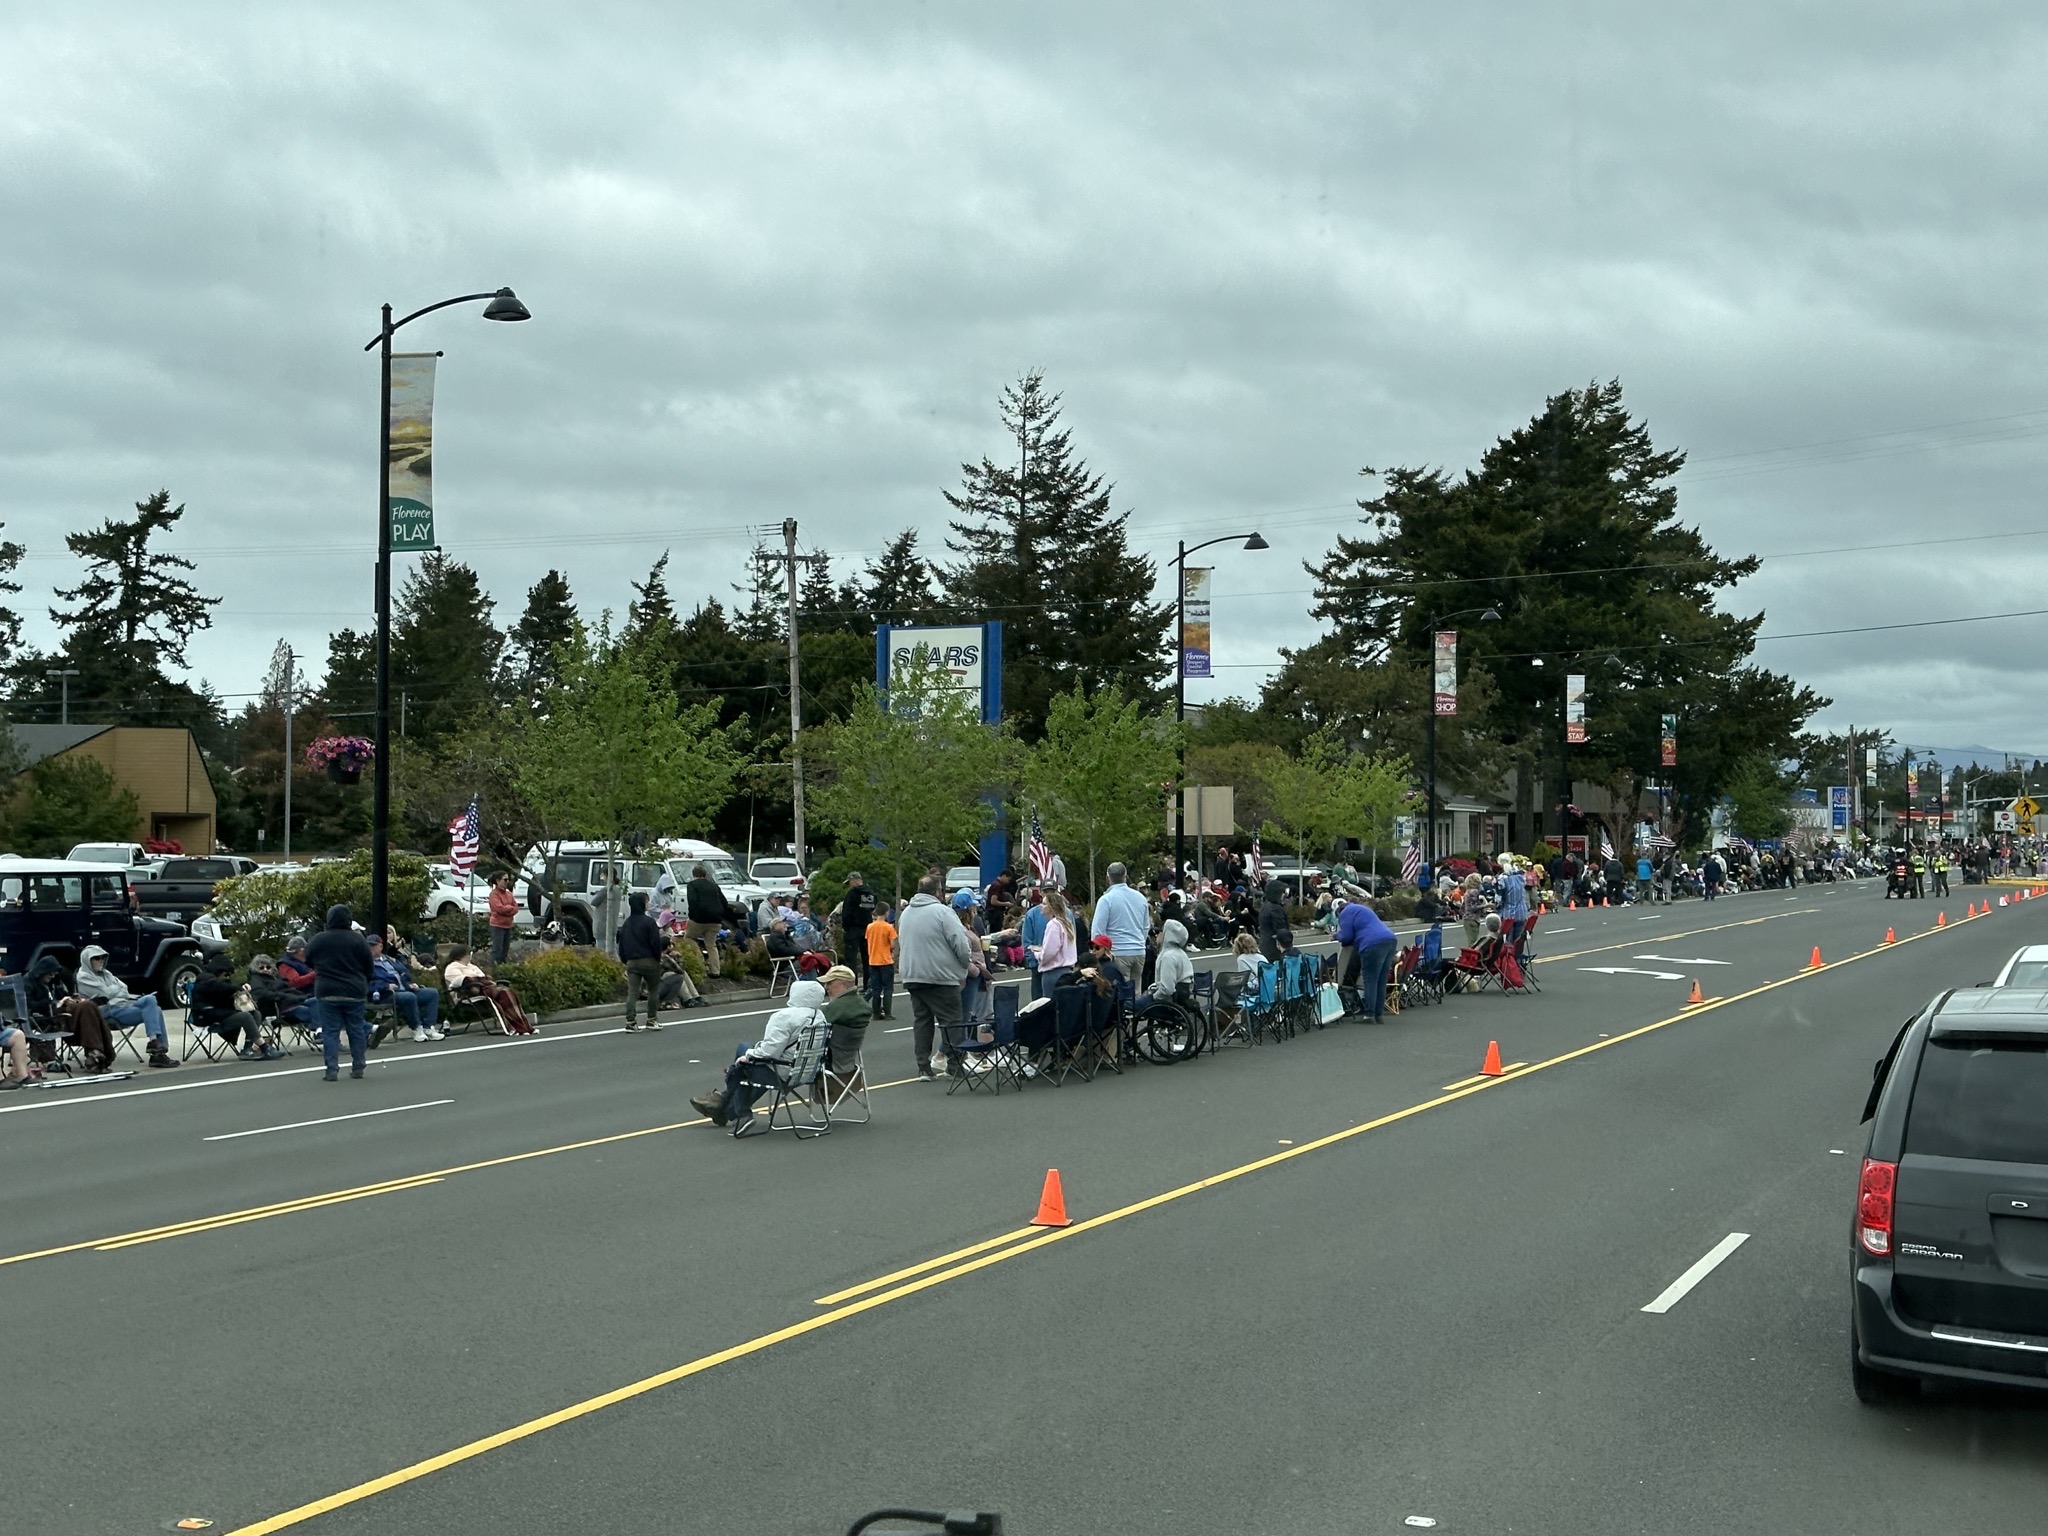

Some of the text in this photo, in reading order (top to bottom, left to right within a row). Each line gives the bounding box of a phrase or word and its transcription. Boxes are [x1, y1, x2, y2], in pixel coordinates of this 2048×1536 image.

[392, 505, 431, 521] Florence
[393, 523, 431, 542] PLAY
[895, 645, 979, 668] SARS
[1435, 703, 1457, 712] SHOP
[1568, 732, 1585, 740] STAY
[1901, 1242, 1937, 1252] GRAND
[1901, 1247, 1964, 1261] CARAVAN
